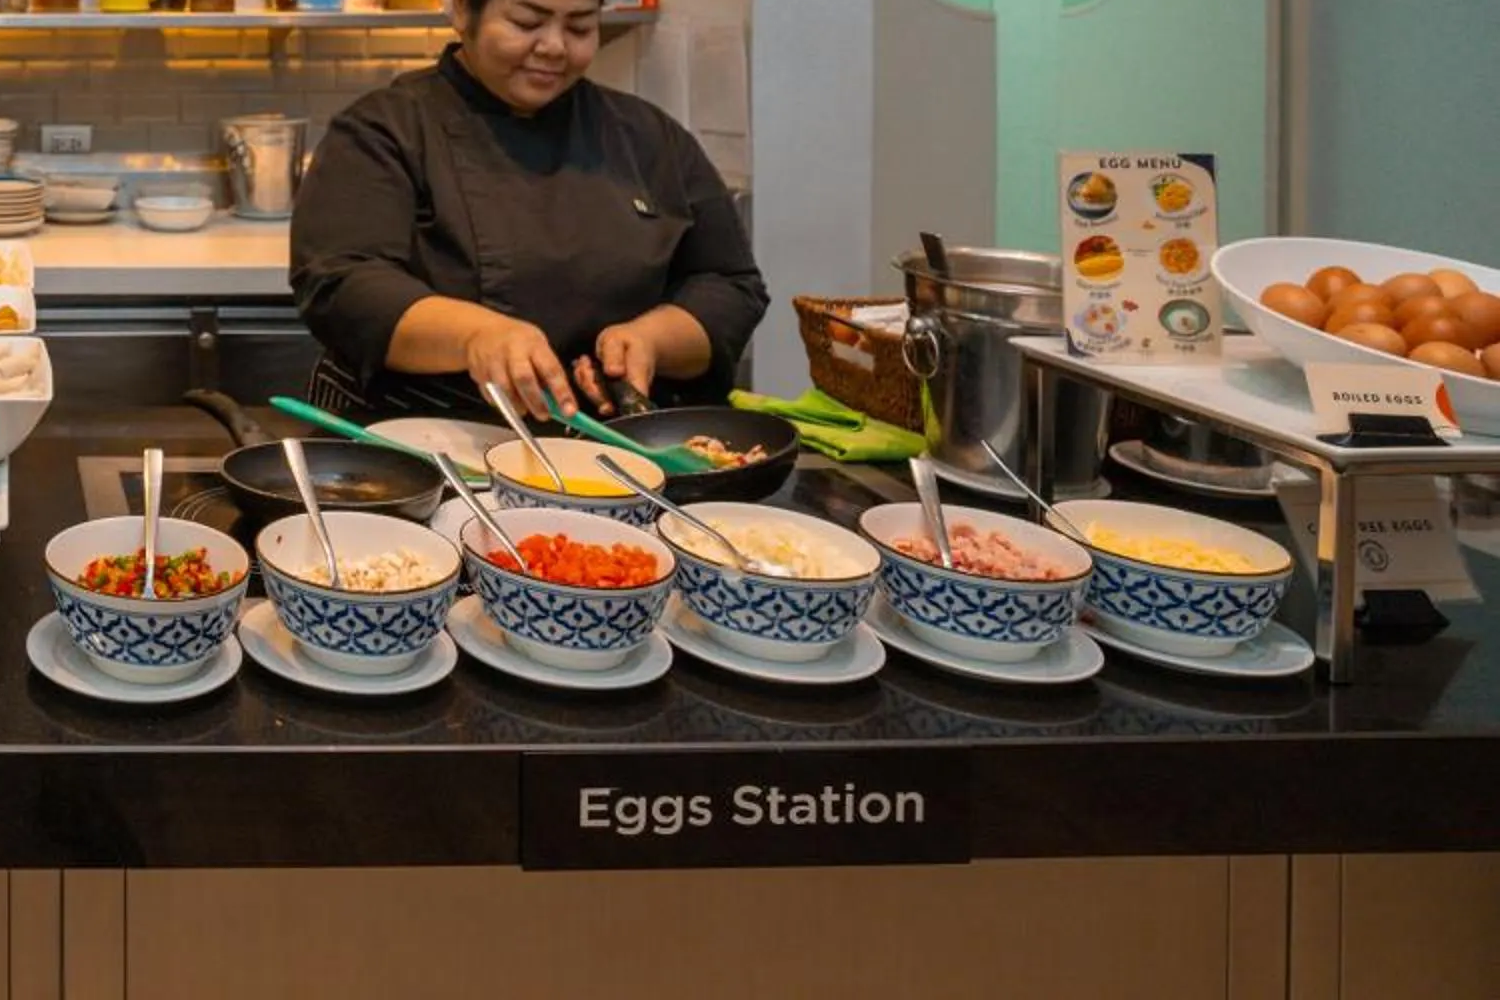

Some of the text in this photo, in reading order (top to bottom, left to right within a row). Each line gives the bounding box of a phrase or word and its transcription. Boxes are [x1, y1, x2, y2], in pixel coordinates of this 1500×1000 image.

[1099, 157, 1183, 170] EGG MENU
[1385, 393, 1423, 405] EGGS
[578, 782, 925, 836] Eggs Station
